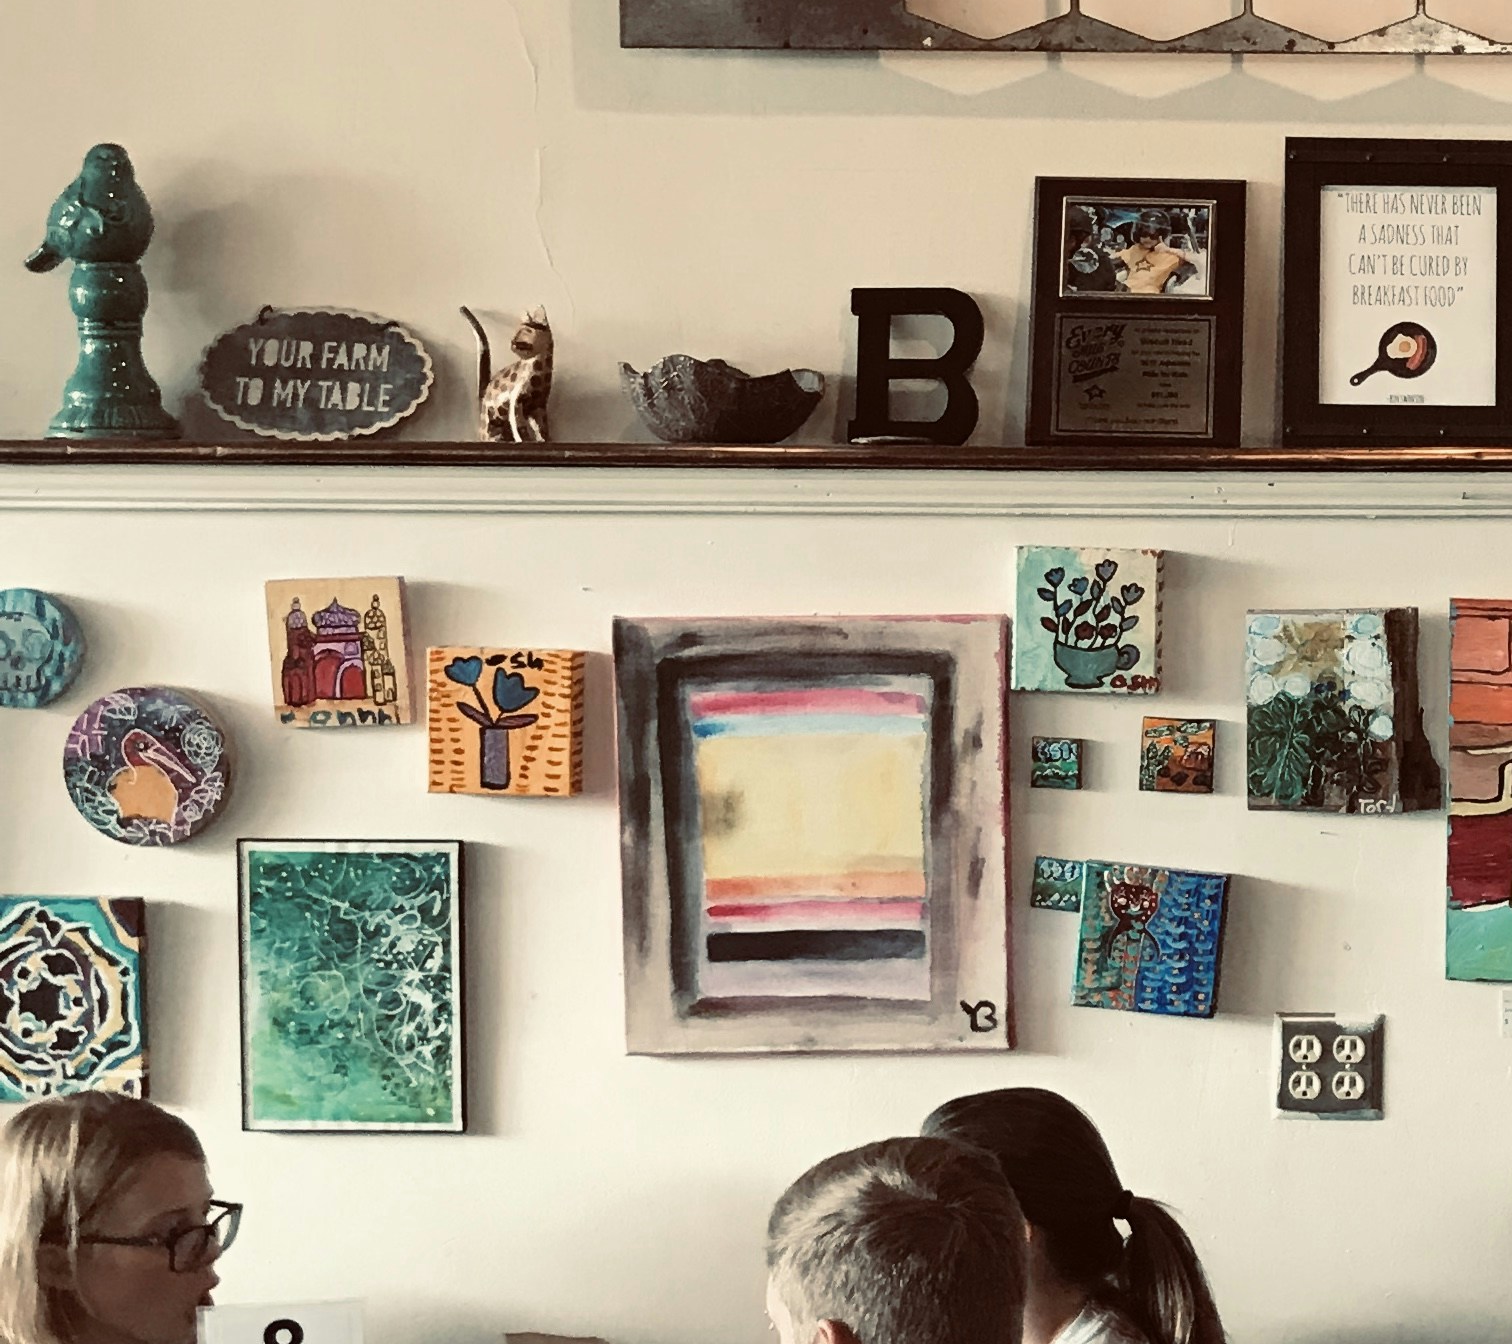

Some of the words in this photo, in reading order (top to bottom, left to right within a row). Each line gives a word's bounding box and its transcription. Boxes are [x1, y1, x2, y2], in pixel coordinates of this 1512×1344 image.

[1382, 193, 1407, 215] HAS
[1410, 193, 1449, 215] NEVER
[1452, 194, 1483, 216] BEEN
[1358, 224, 1367, 244] A
[1370, 224, 1427, 245] SADNESS
[1431, 224, 1460, 245] THAT
[1348, 253, 1389, 276] CAN'T
[1391, 254, 1405, 276] BE
[1409, 255, 1450, 276] CURED
[1454, 256, 1469, 277] BY
[1352, 284, 1420, 307] BREAKFAST
[249, 338, 314, 369] YOUR
[320, 341, 391, 373] FARM
[847, 287, 985, 447] B
[235, 376, 265, 407] TO
[272, 378, 312, 409] MY
[318, 381, 395, 413] TABLE
